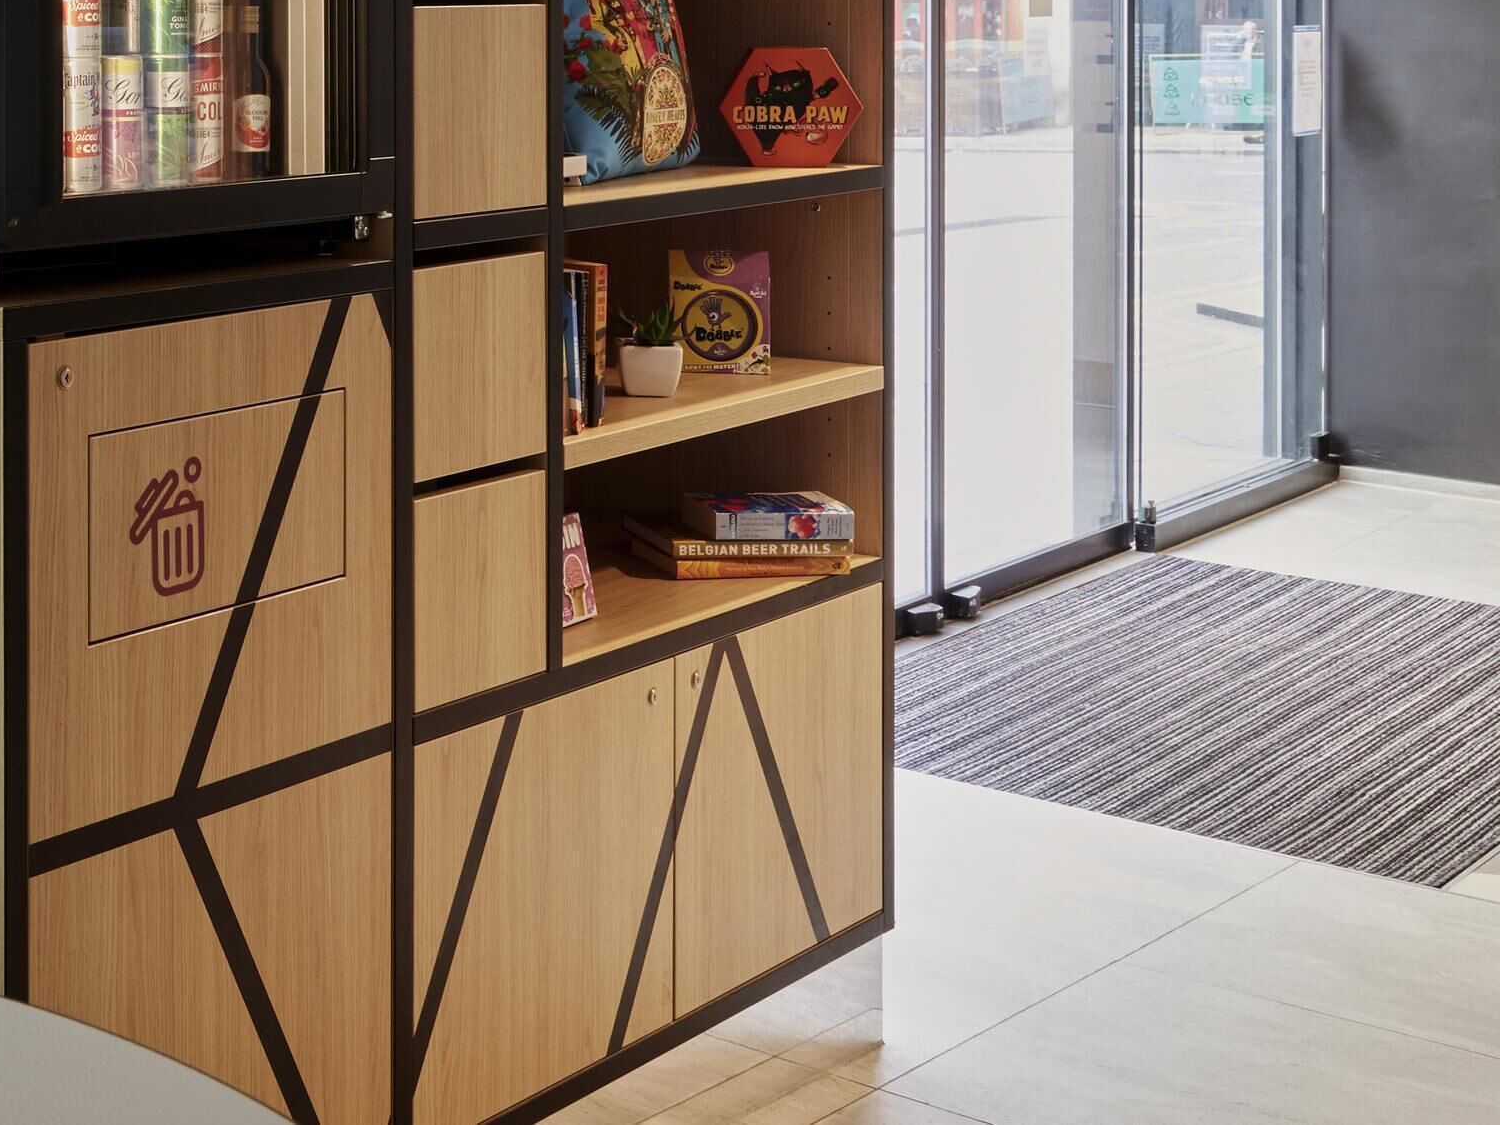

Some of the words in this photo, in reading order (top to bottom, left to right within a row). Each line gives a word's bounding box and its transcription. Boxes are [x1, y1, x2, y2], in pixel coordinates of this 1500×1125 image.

[732, 105, 797, 123] COBRA
[805, 105, 848, 124] PAW
[678, 544, 738, 556] BELGIAN
[742, 543, 777, 556] BEER
[781, 543, 831, 555] TRAILS
